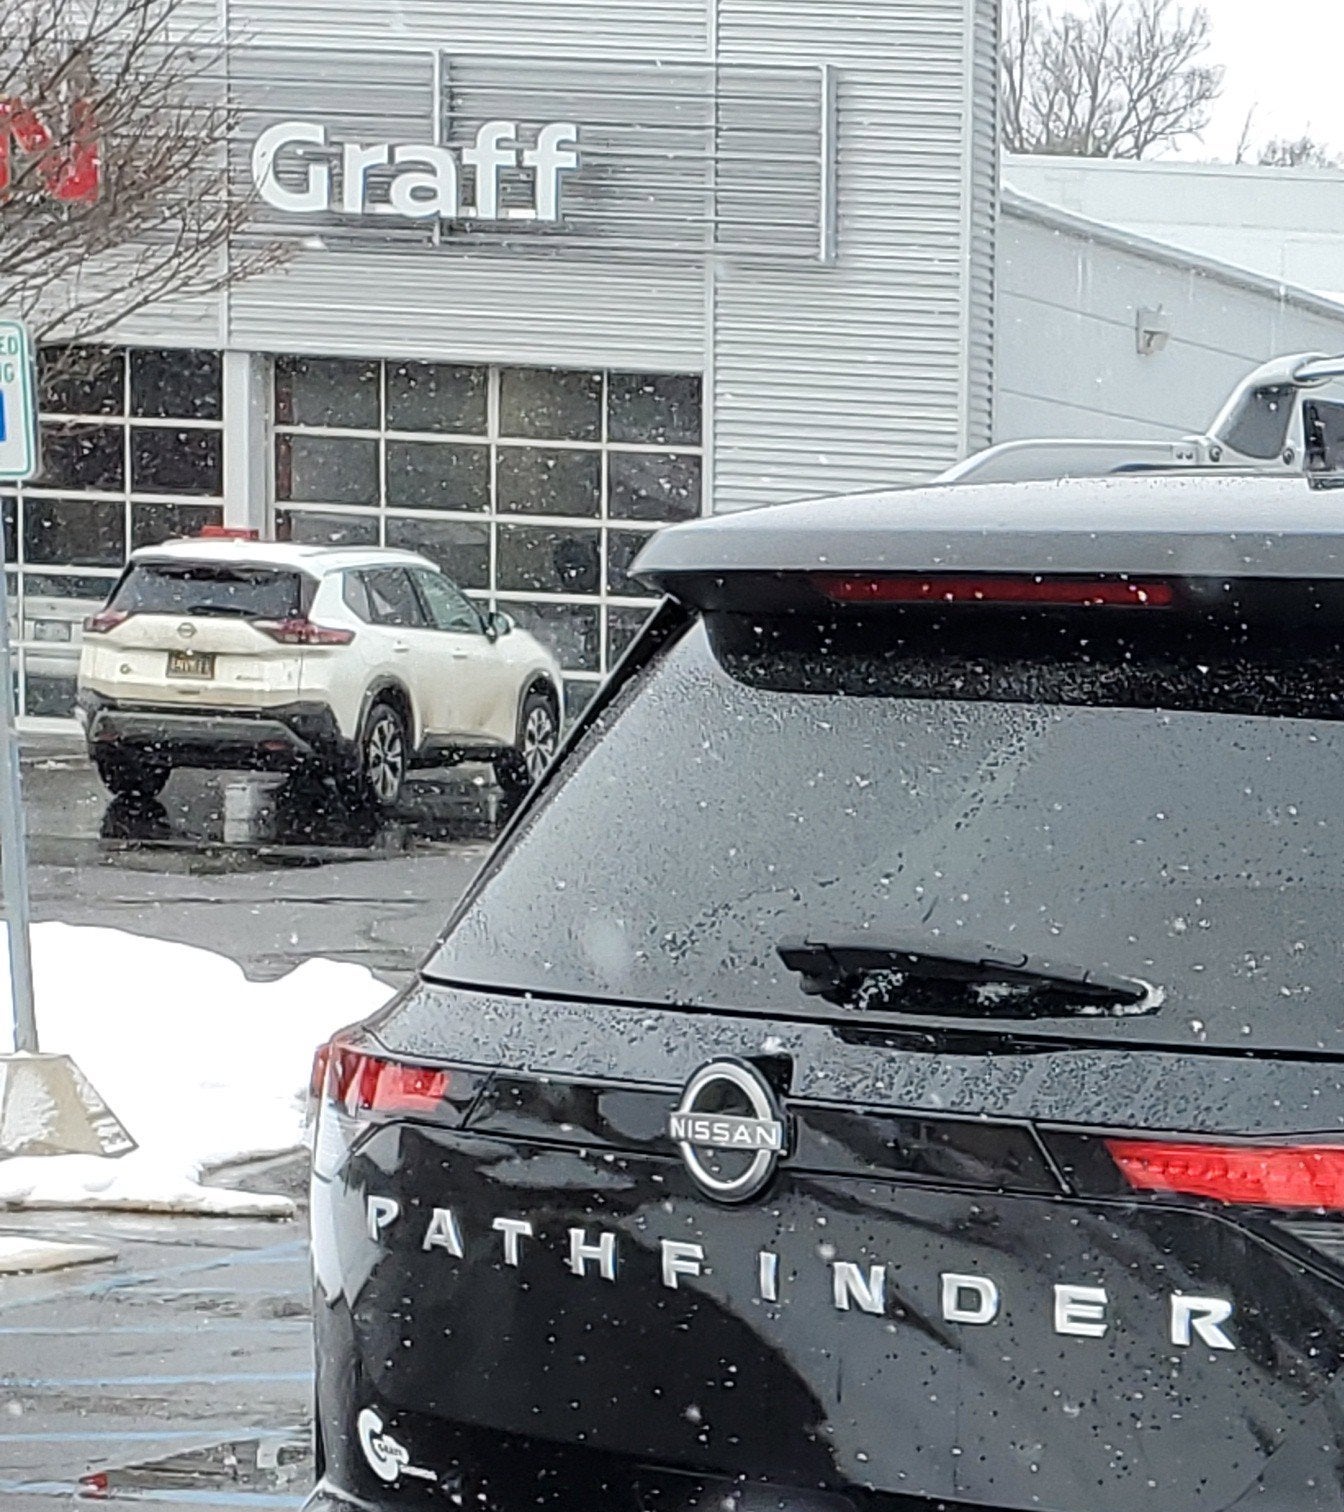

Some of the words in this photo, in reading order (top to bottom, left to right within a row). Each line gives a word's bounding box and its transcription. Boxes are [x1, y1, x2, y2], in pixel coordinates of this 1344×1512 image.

[252, 120, 579, 220] Graff
[670, 1118, 776, 1145] NISSAN
[365, 1195, 1236, 1350] PATHFINDER
